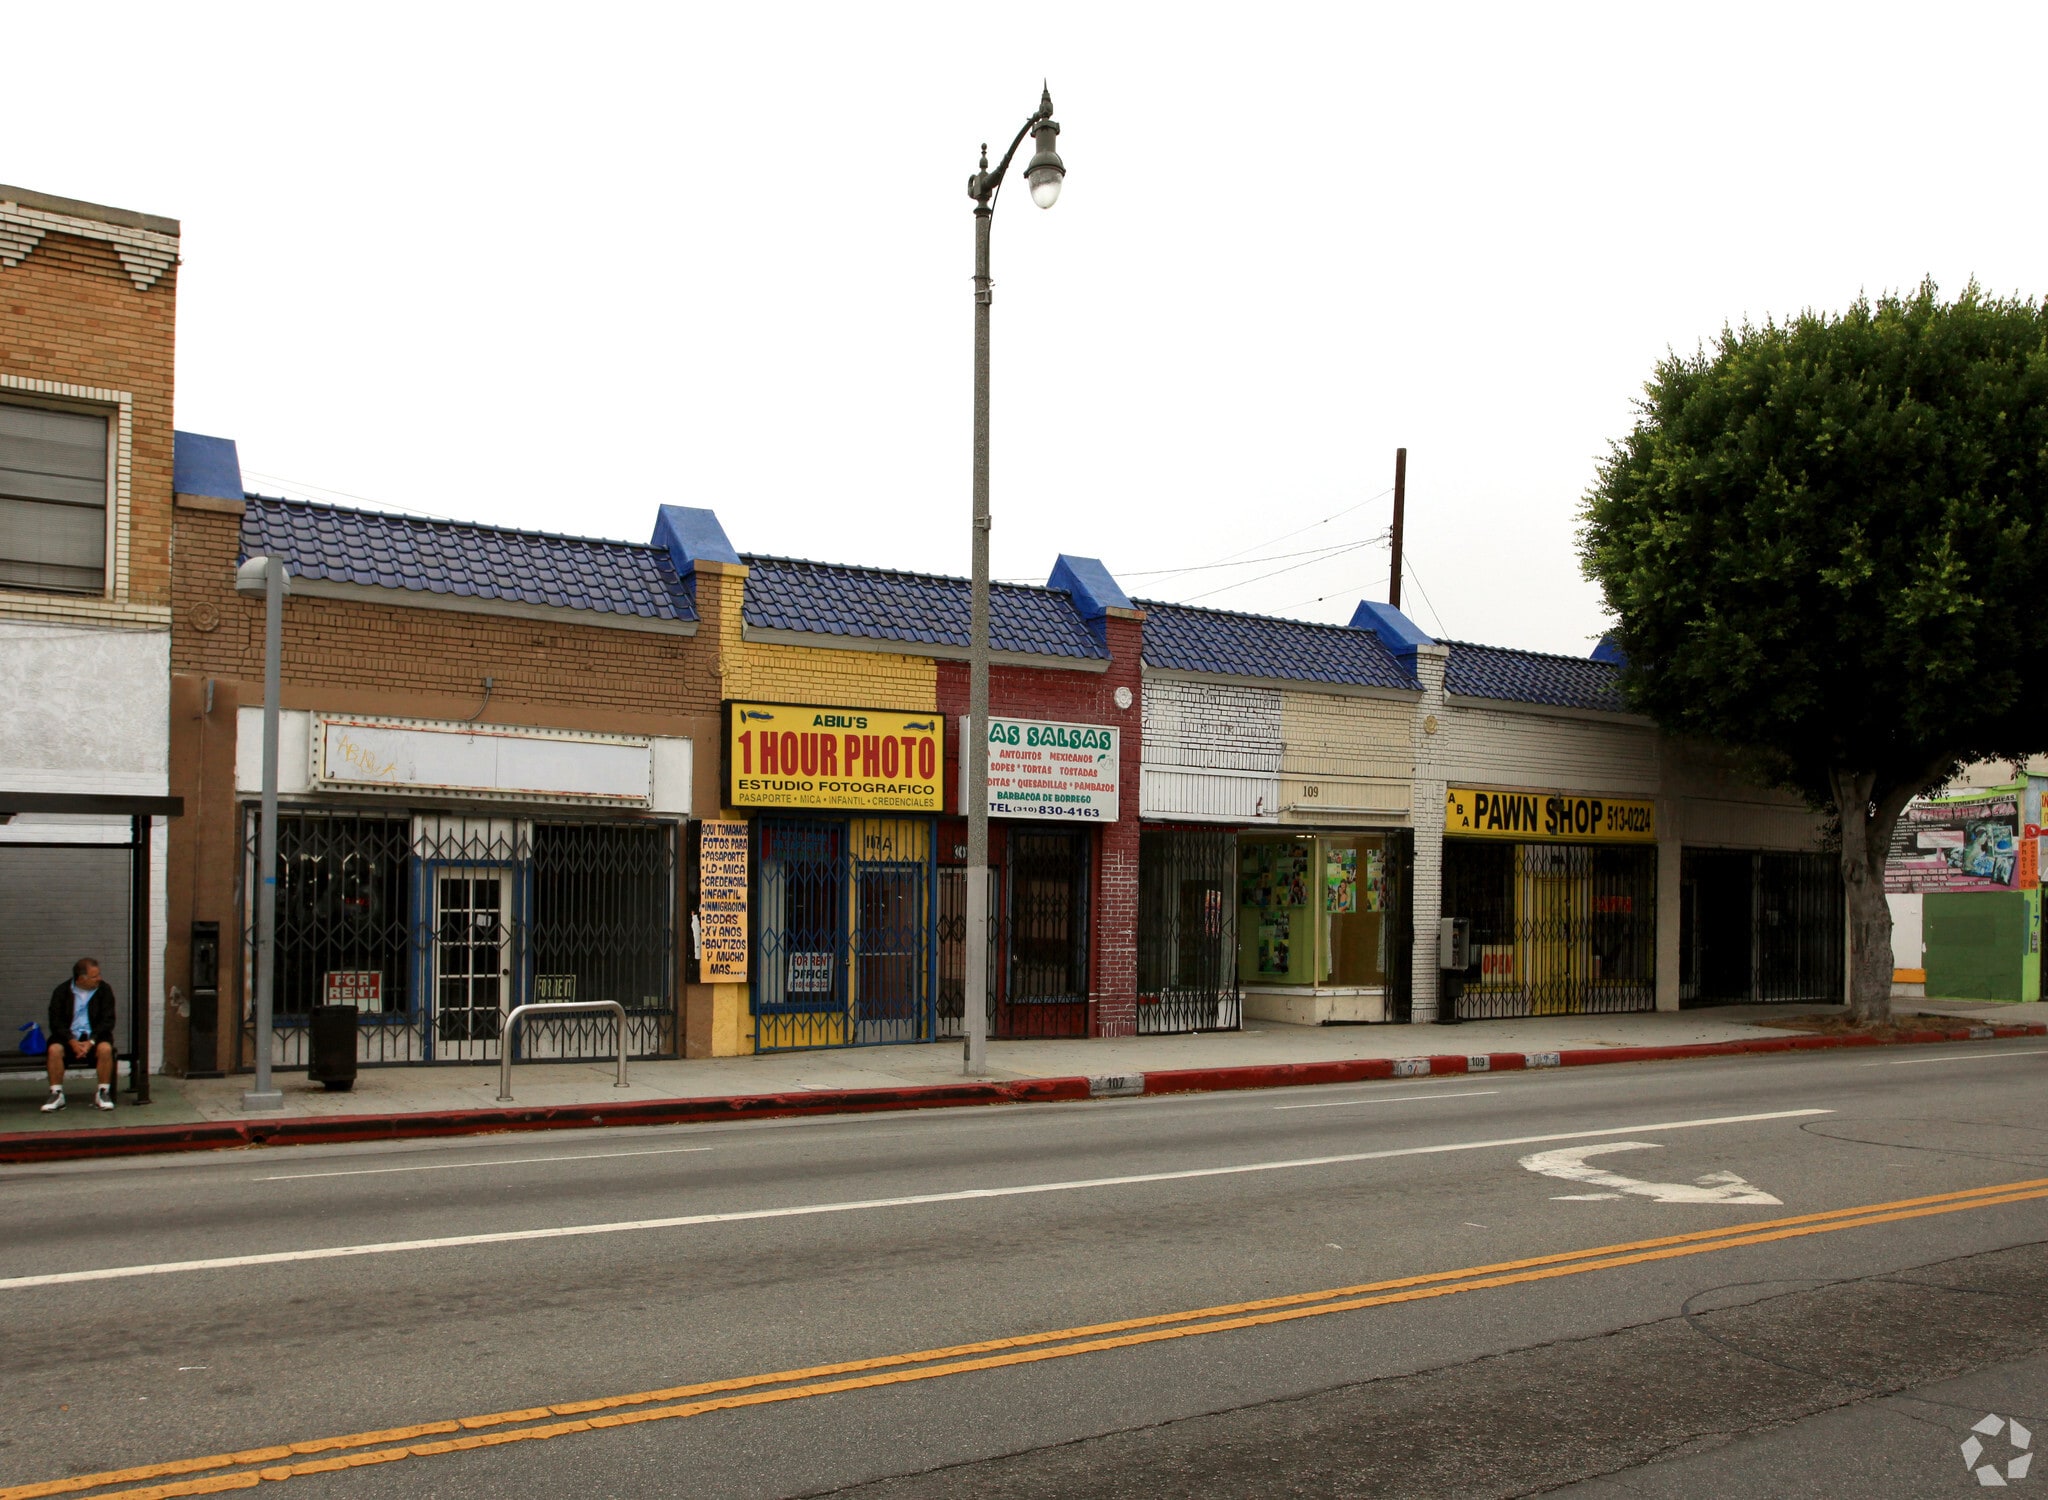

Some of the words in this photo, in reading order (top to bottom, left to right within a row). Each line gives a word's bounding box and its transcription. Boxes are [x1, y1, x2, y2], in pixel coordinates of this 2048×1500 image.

[812, 714, 868, 729] ABIU'S
[1027, 726, 1112, 750] SALSAS
[738, 731, 752, 775] 1
[760, 731, 838, 777] HOUR
[844, 734, 936, 780] PHOTO
[1000, 749, 1042, 760] ANTOJITOS
[1050, 752, 1093, 763] MEXICANOS
[990, 762, 1016, 772] SOPES
[1022, 765, 1053, 775] TORTAS
[1060, 767, 1098, 778] TOSTADAS
[738, 780, 813, 791] ESTUDIO
[819, 782, 935, 795] FOTOGRAFICO
[1017, 779, 1068, 791] QUESADILLAS
[1074, 781, 1115, 793] PAMBAZOS
[1303, 785, 1319, 798] 109
[739, 793, 792, 804] PASAPORTE
[800, 795, 821, 805] MICA
[828, 795, 866, 806] INFANTIL
[872, 796, 934, 808] CREDENCIALES
[997, 791, 1041, 802] BARBACOA
[1043, 793, 1053, 802] DE
[1054, 794, 1092, 804] BORREGO
[989, 803, 1012, 813] TEL
[1013, 806, 1037, 814] (310)
[1039, 805, 1100, 818] 830-4163
[1475, 793, 1538, 832] PAWN
[1545, 797, 1603, 835] SHOP
[1607, 805, 1651, 833] 513-0224
[717, 824, 748, 836] TOMAMOS
[702, 838, 729, 849] FOTOS
[731, 838, 748, 850] PARA
[882, 837, 892, 851] A
[706, 852, 745, 862] PASAPORTE
[723, 864, 746, 874] MICA
[705, 877, 747, 888] CREDENCIAL
[705, 889, 740, 900] INFANTIL
[705, 902, 747, 912] INMIGRACION
[706, 914, 738, 924] BODAS
[705, 927, 718, 937] XV
[706, 939, 747, 950] BAUTIZOS
[706, 952, 713, 962] Y
[717, 952, 744, 962] MUCHO
[1483, 954, 1513, 974] OPEN
[335, 975, 369, 986] FOR
[329, 987, 376, 998] RENT
[1471, 1056, 1485, 1067] 109
[1107, 1077, 1124, 1088] 107
